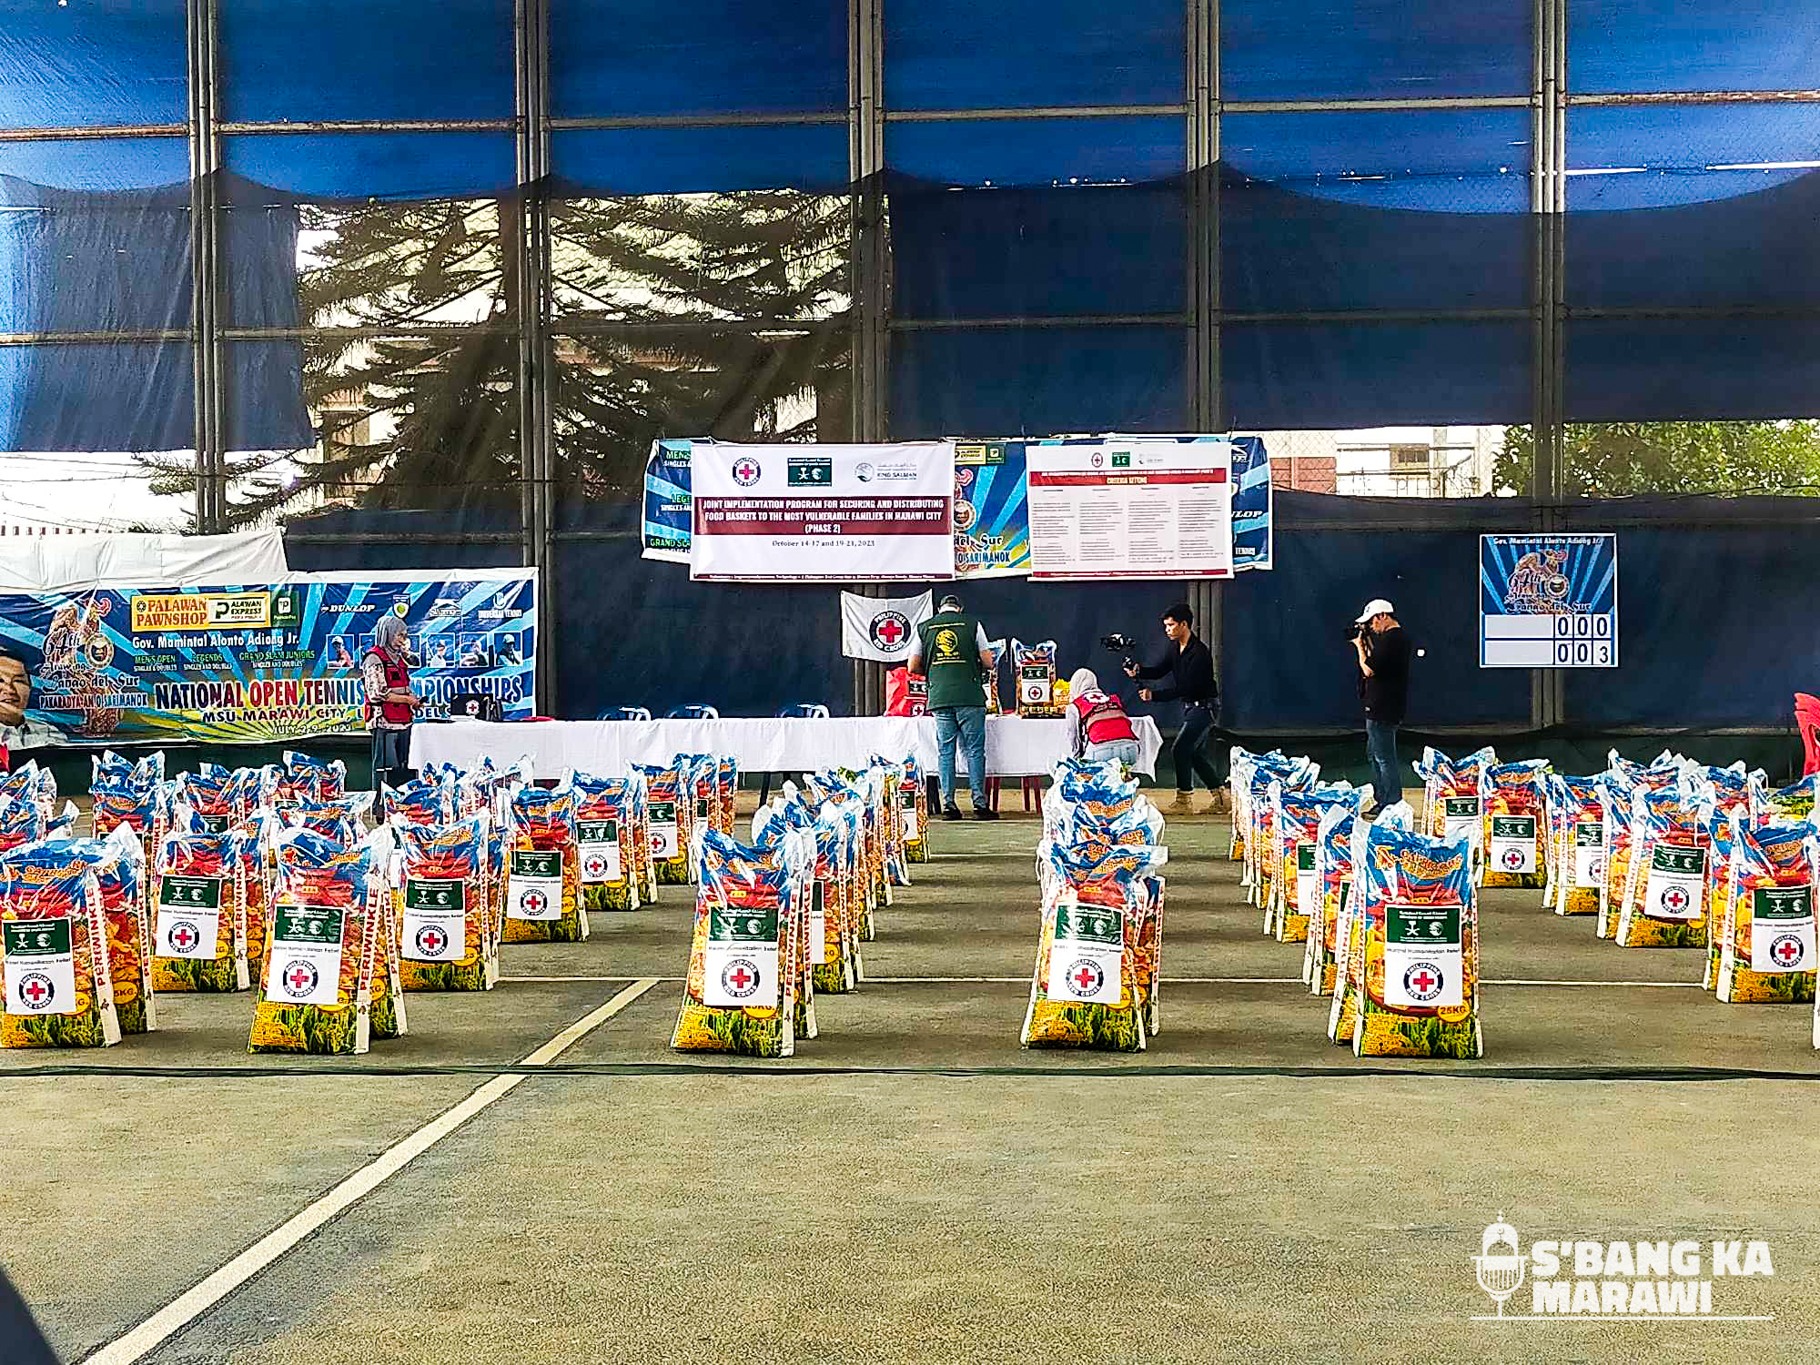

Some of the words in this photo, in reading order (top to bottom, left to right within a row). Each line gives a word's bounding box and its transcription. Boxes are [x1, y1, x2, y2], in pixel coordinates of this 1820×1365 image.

[703, 500, 723, 509] JOINT
[724, 500, 784, 509] IMPLEMENTATION
[785, 500, 822, 509] PROGRAM
[823, 500, 838, 509] FOR
[839, 500, 875, 509] SECURING
[877, 500, 892, 509] AND
[893, 500, 944, 509] DISTRIBUTING
[704, 511, 724, 521] FOOD
[725, 511, 757, 520] BASKETS
[758, 511, 768, 520] TO
[769, 511, 783, 520] THE
[784, 511, 804, 520] MOST
[805, 511, 850, 520] VULNERABLE
[851, 511, 884, 520] FAMILIES
[885, 511, 893, 520] IN
[894, 511, 925, 520] MARAWI
[926, 511, 943, 520] CITY
[804, 523, 832, 534] (PHASE
[833, 523, 841, 534] 2)
[650, 538, 676, 547] GRAND
[148, 599, 207, 612] PALAWAN
[328, 604, 375, 613] DUNLOP
[136, 612, 208, 626] PAWNSHOP
[1557, 616, 1569, 636] 0
[1577, 616, 1589, 636] 0
[1596, 616, 1608, 636] 0
[132, 637, 155, 649] Gov.
[157, 635, 208, 649] Mamintal
[210, 634, 244, 647] Alonto
[248, 633, 284, 648] Adiong
[287, 632, 299, 645] Jr.
[1557, 643, 1569, 663] 0
[1577, 643, 1589, 663] 0
[1599, 645, 1609, 663] 3
[91, 674, 109, 688] del
[155, 681, 244, 710] NATIONAL
[249, 680, 299, 708] OPEN
[304, 677, 365, 706] TENNIS
[203, 710, 236, 723] MSU
[243, 708, 310, 722] MARAWI
[316, 708, 351, 722] CITY,
[417, 706, 441, 719] DEL
[86, 887, 106, 987] PERIWINKLE
[360, 887, 379, 991] PERIWINKLE
[785, 893, 798, 997] PERIWINKLE
[113, 988, 137, 997] 5KG.
